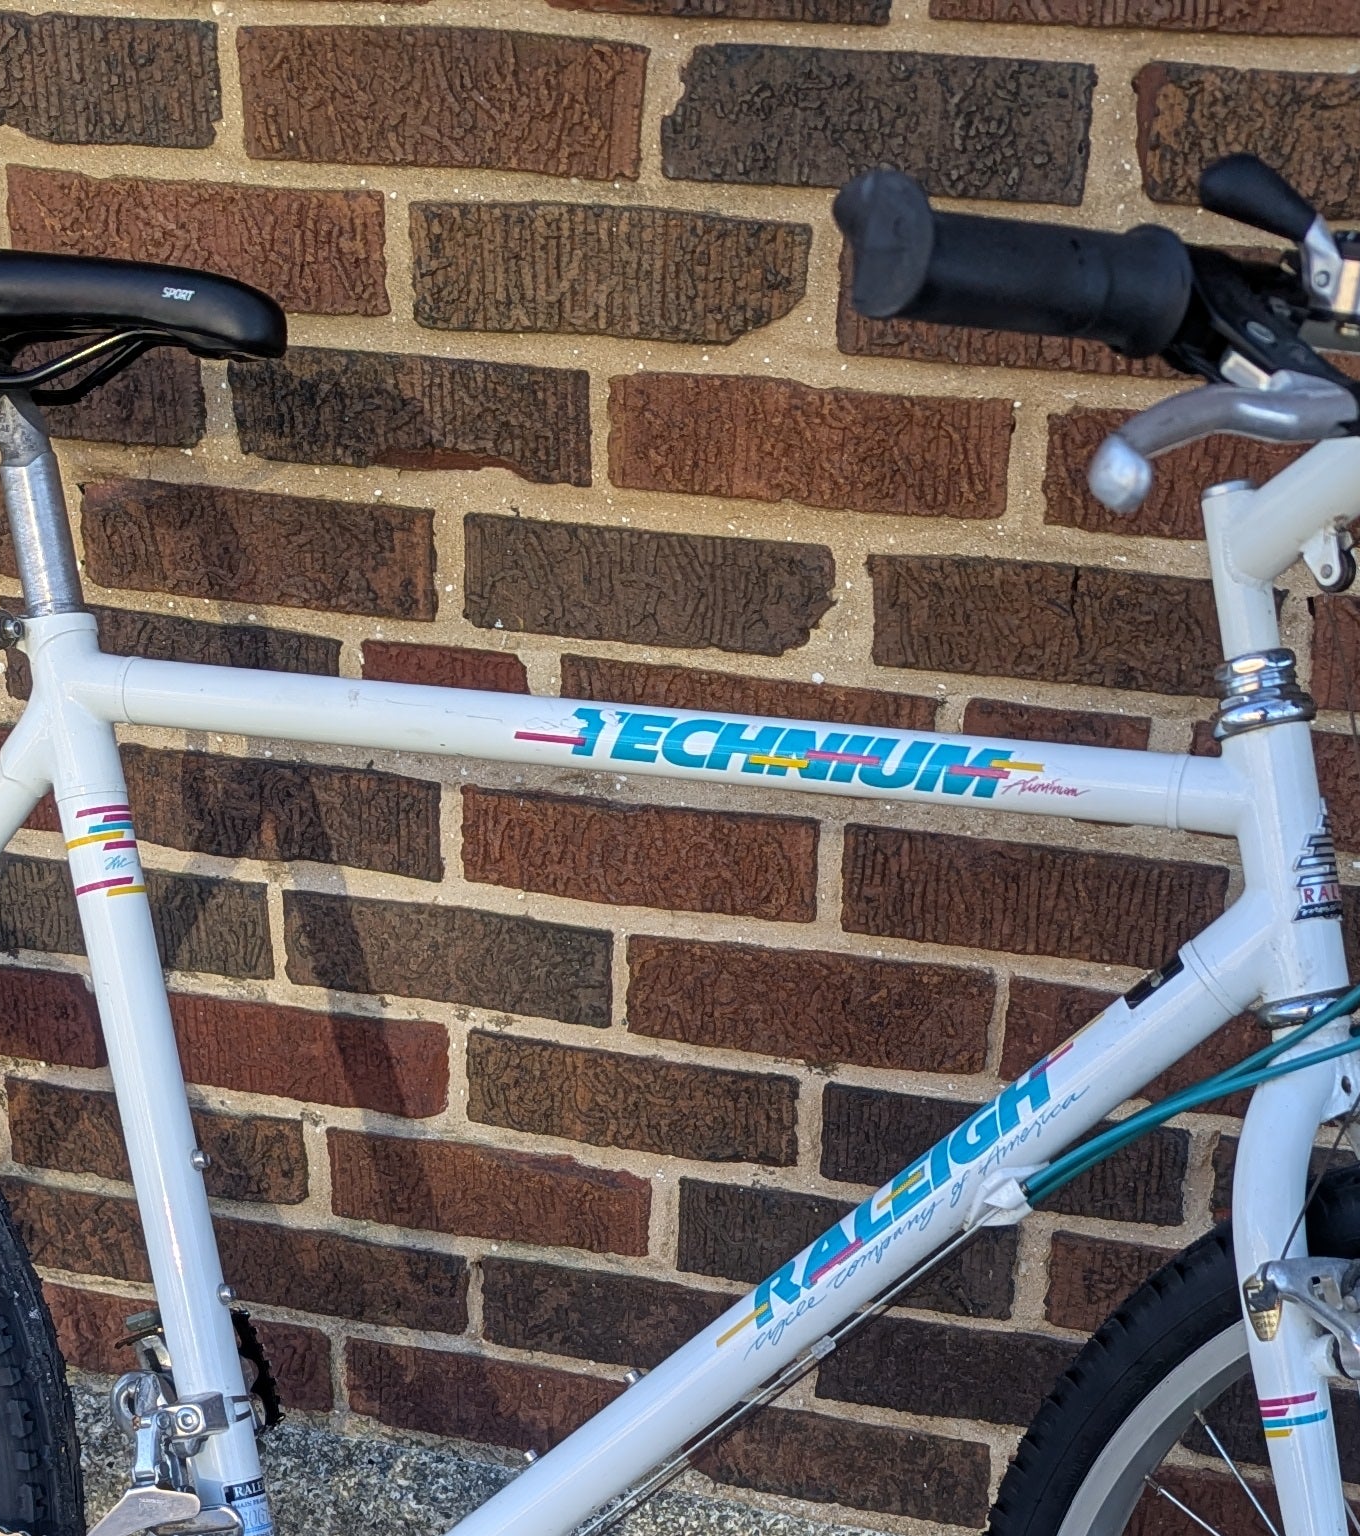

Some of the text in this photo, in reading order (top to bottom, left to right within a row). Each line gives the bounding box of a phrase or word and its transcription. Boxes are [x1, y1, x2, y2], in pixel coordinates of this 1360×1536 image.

[161, 286, 196, 301] SPORT
[570, 707, 1013, 799] TECHNIUM
[753, 1057, 1052, 1330] RALEIGH
[826, 1198, 945, 1290] company
[949, 1169, 971, 1208] of
[978, 1085, 1091, 1176] America
